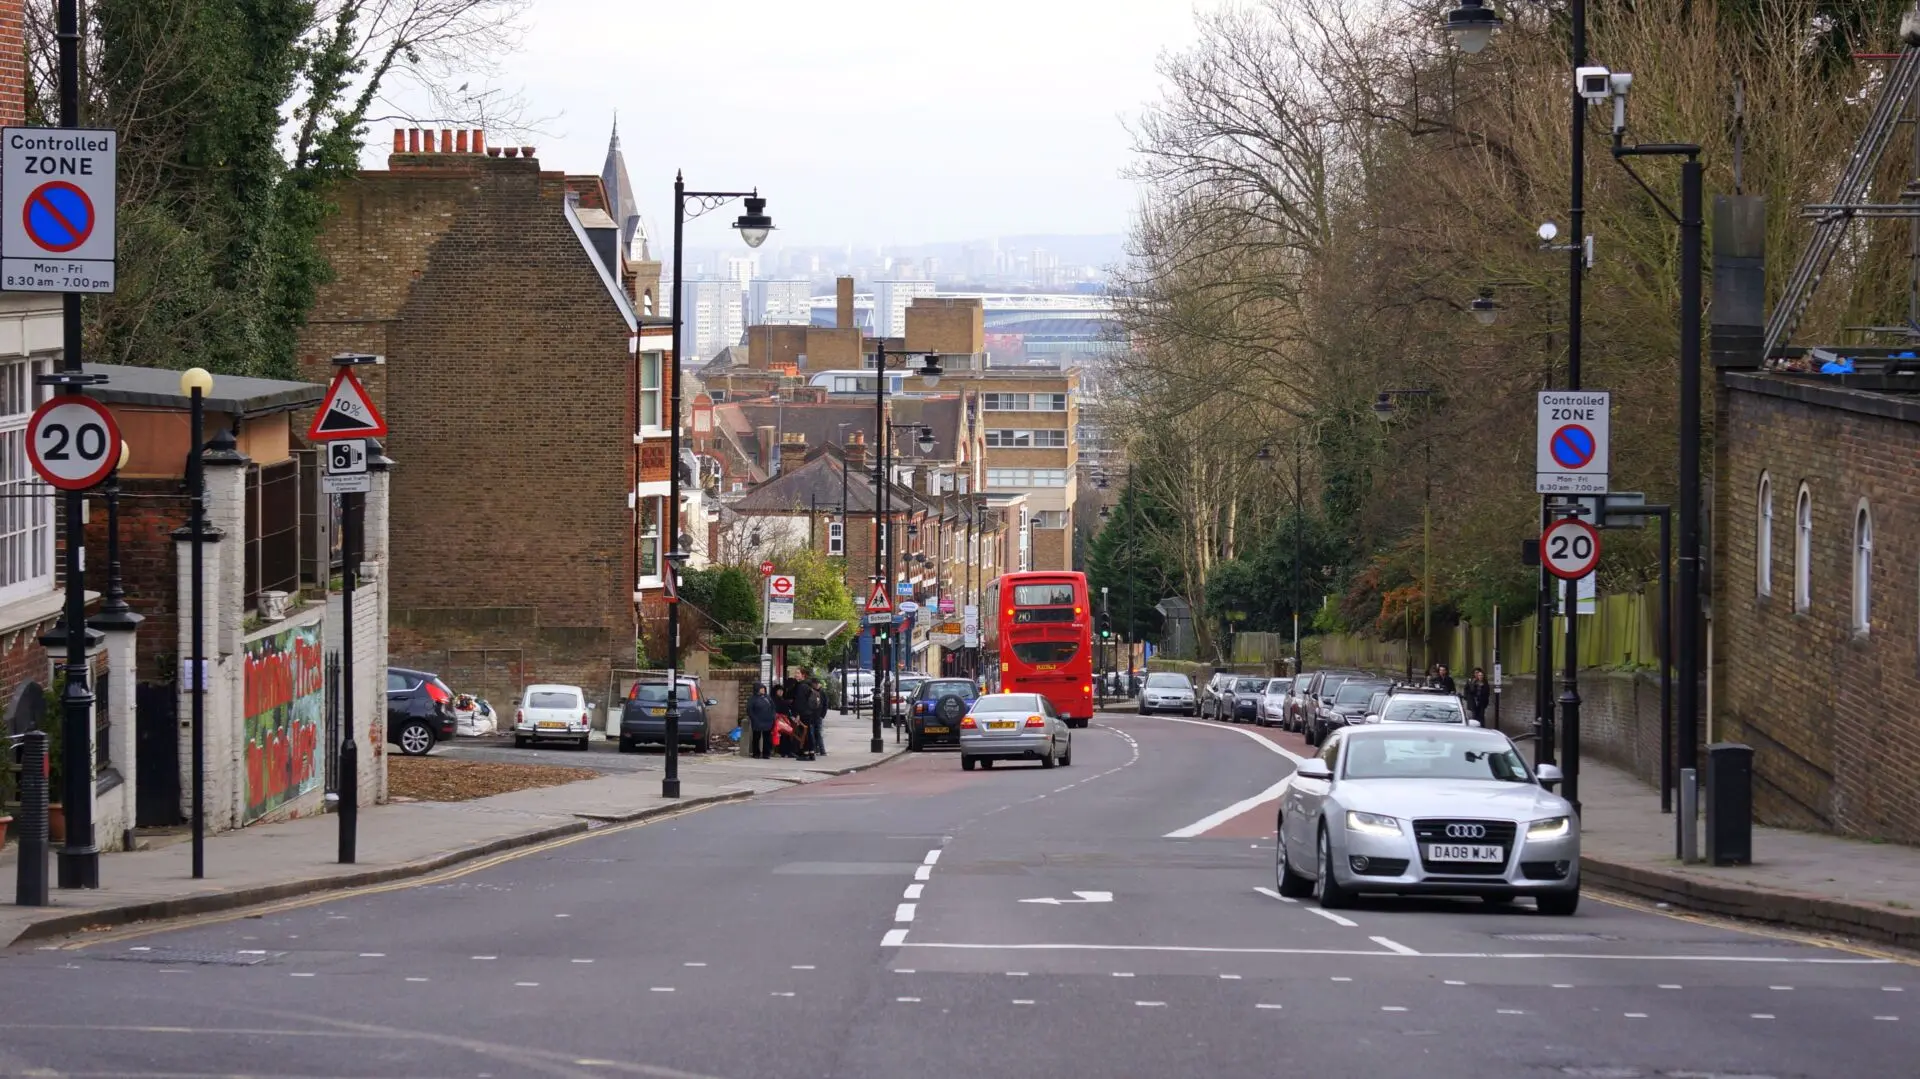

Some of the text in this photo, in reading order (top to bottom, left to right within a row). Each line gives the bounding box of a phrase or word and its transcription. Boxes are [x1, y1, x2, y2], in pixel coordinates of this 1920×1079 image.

[11, 135, 108, 151] Controlled
[25, 156, 93, 175] ZONE
[34, 263, 58, 273] Mon
[68, 264, 83, 273] Fri
[7, 276, 34, 286] 8.30
[37, 279, 54, 287] am
[62, 277, 89, 287] 7.00
[92, 280, 109, 288] pm
[1543, 395, 1604, 405] Controlled
[335, 398, 361, 417] 10%
[1551, 409, 1595, 420] ZONE
[42, 423, 106, 461] 20
[1551, 535, 1592, 559] 20
[1434, 846, 1498, 859] DA08 WJK
